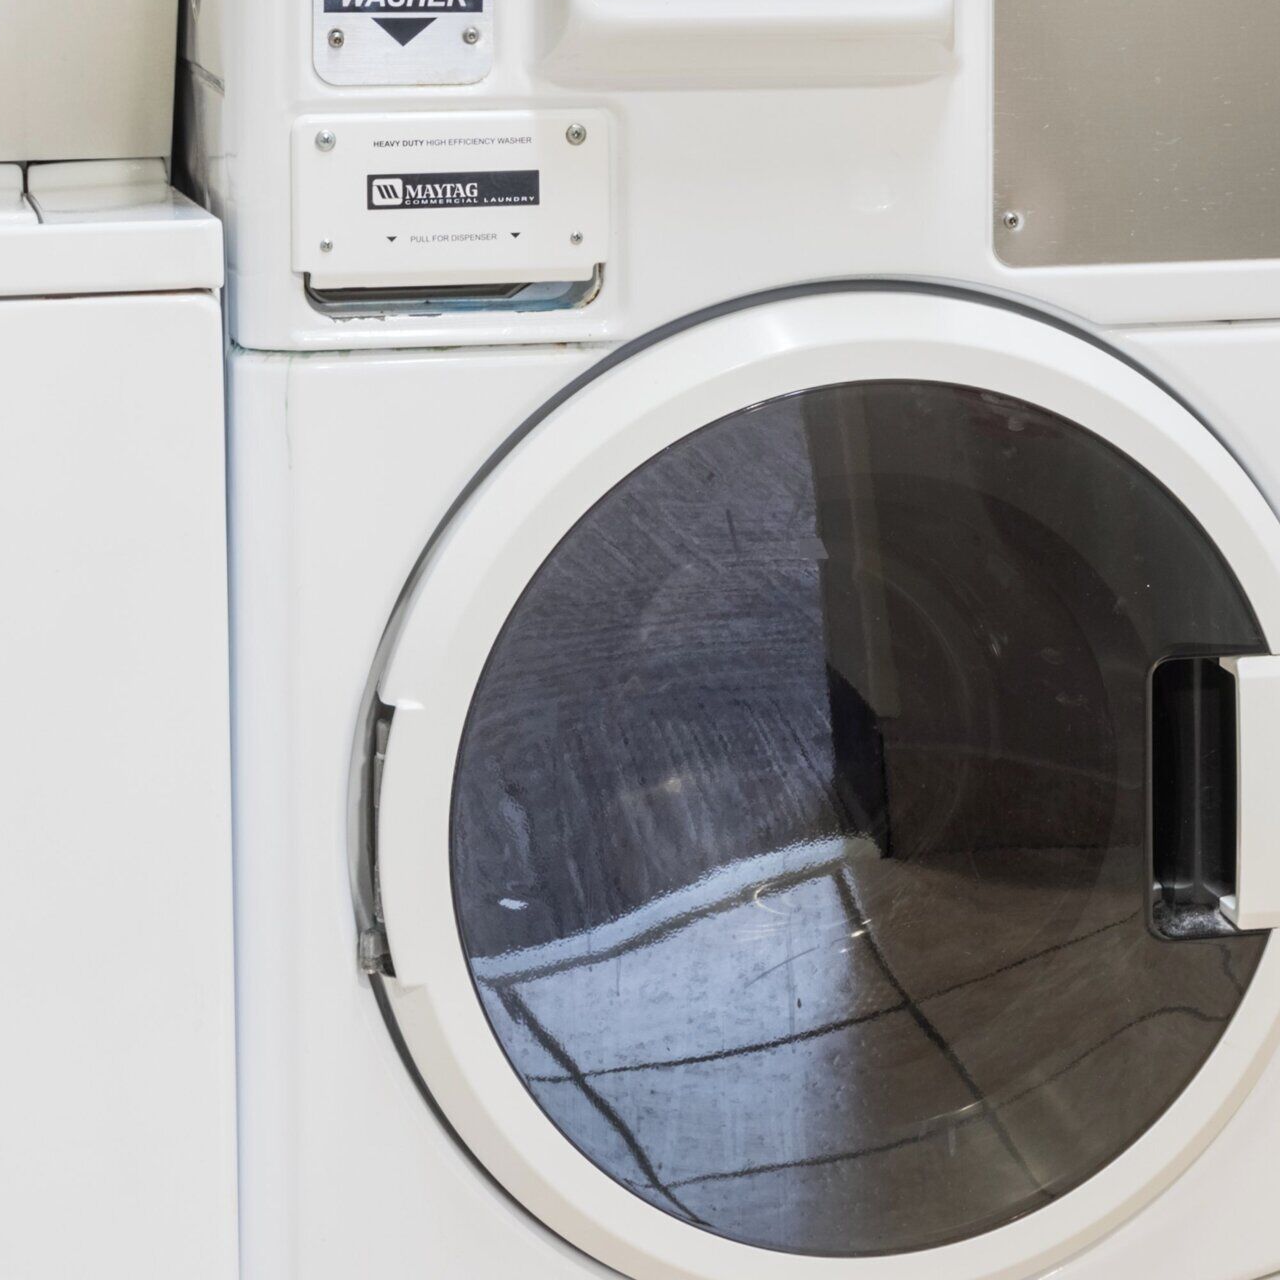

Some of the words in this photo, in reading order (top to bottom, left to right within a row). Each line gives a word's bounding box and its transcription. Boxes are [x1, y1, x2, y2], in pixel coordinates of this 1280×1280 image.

[373, 140, 400, 148] HEAVY
[402, 139, 425, 147] DUTY
[448, 138, 495, 146] EFFICIENCY
[497, 137, 532, 145] WASHER
[405, 182, 478, 199] MAYTAG
[410, 235, 430, 243] PULL
[451, 233, 497, 242] DISPENSER
